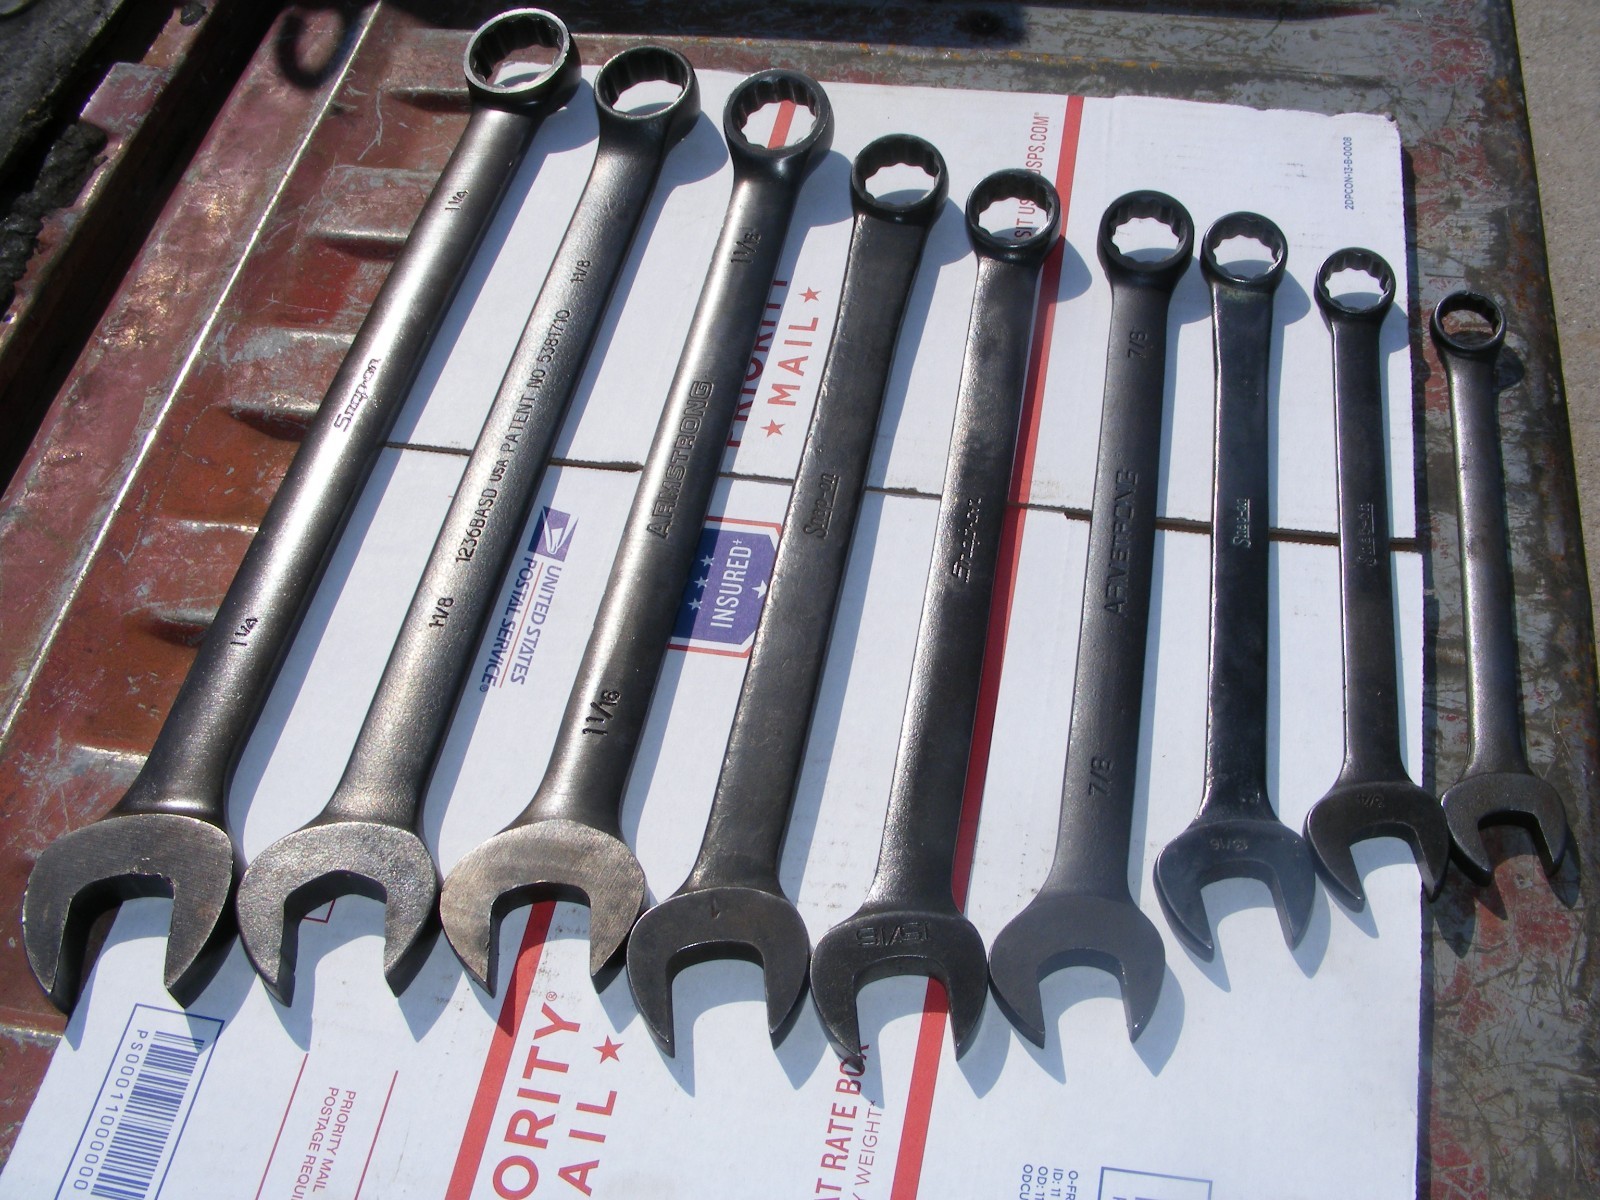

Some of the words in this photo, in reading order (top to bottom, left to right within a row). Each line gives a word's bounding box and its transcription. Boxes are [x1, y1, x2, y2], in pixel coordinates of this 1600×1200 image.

[1343, 136, 1355, 211] 2DPCON-13-B-0008
[1014, 217, 1034, 238] SIT
[767, 317, 819, 407] MAIL
[333, 358, 381, 432] Snap-on
[489, 459, 510, 482] USA
[500, 395, 536, 453] PATENT
[526, 368, 547, 389] NO
[646, 381, 715, 540] ARMSTRONG
[504, 556, 538, 617] POSTAL
[530, 564, 562, 626] UNITED
[510, 625, 541, 686] STATES
[308, 1086, 340, 1152] POSTAGE
[326, 1090, 357, 1156] PRIORITY
[820, 1103, 857, 1171] RATE
[291, 1154, 317, 1200] REQUI
[312, 1158, 334, 1192] MAIL
[1036, 1166, 1048, 1188] OD:
[1053, 1168, 1064, 1184] ID:
